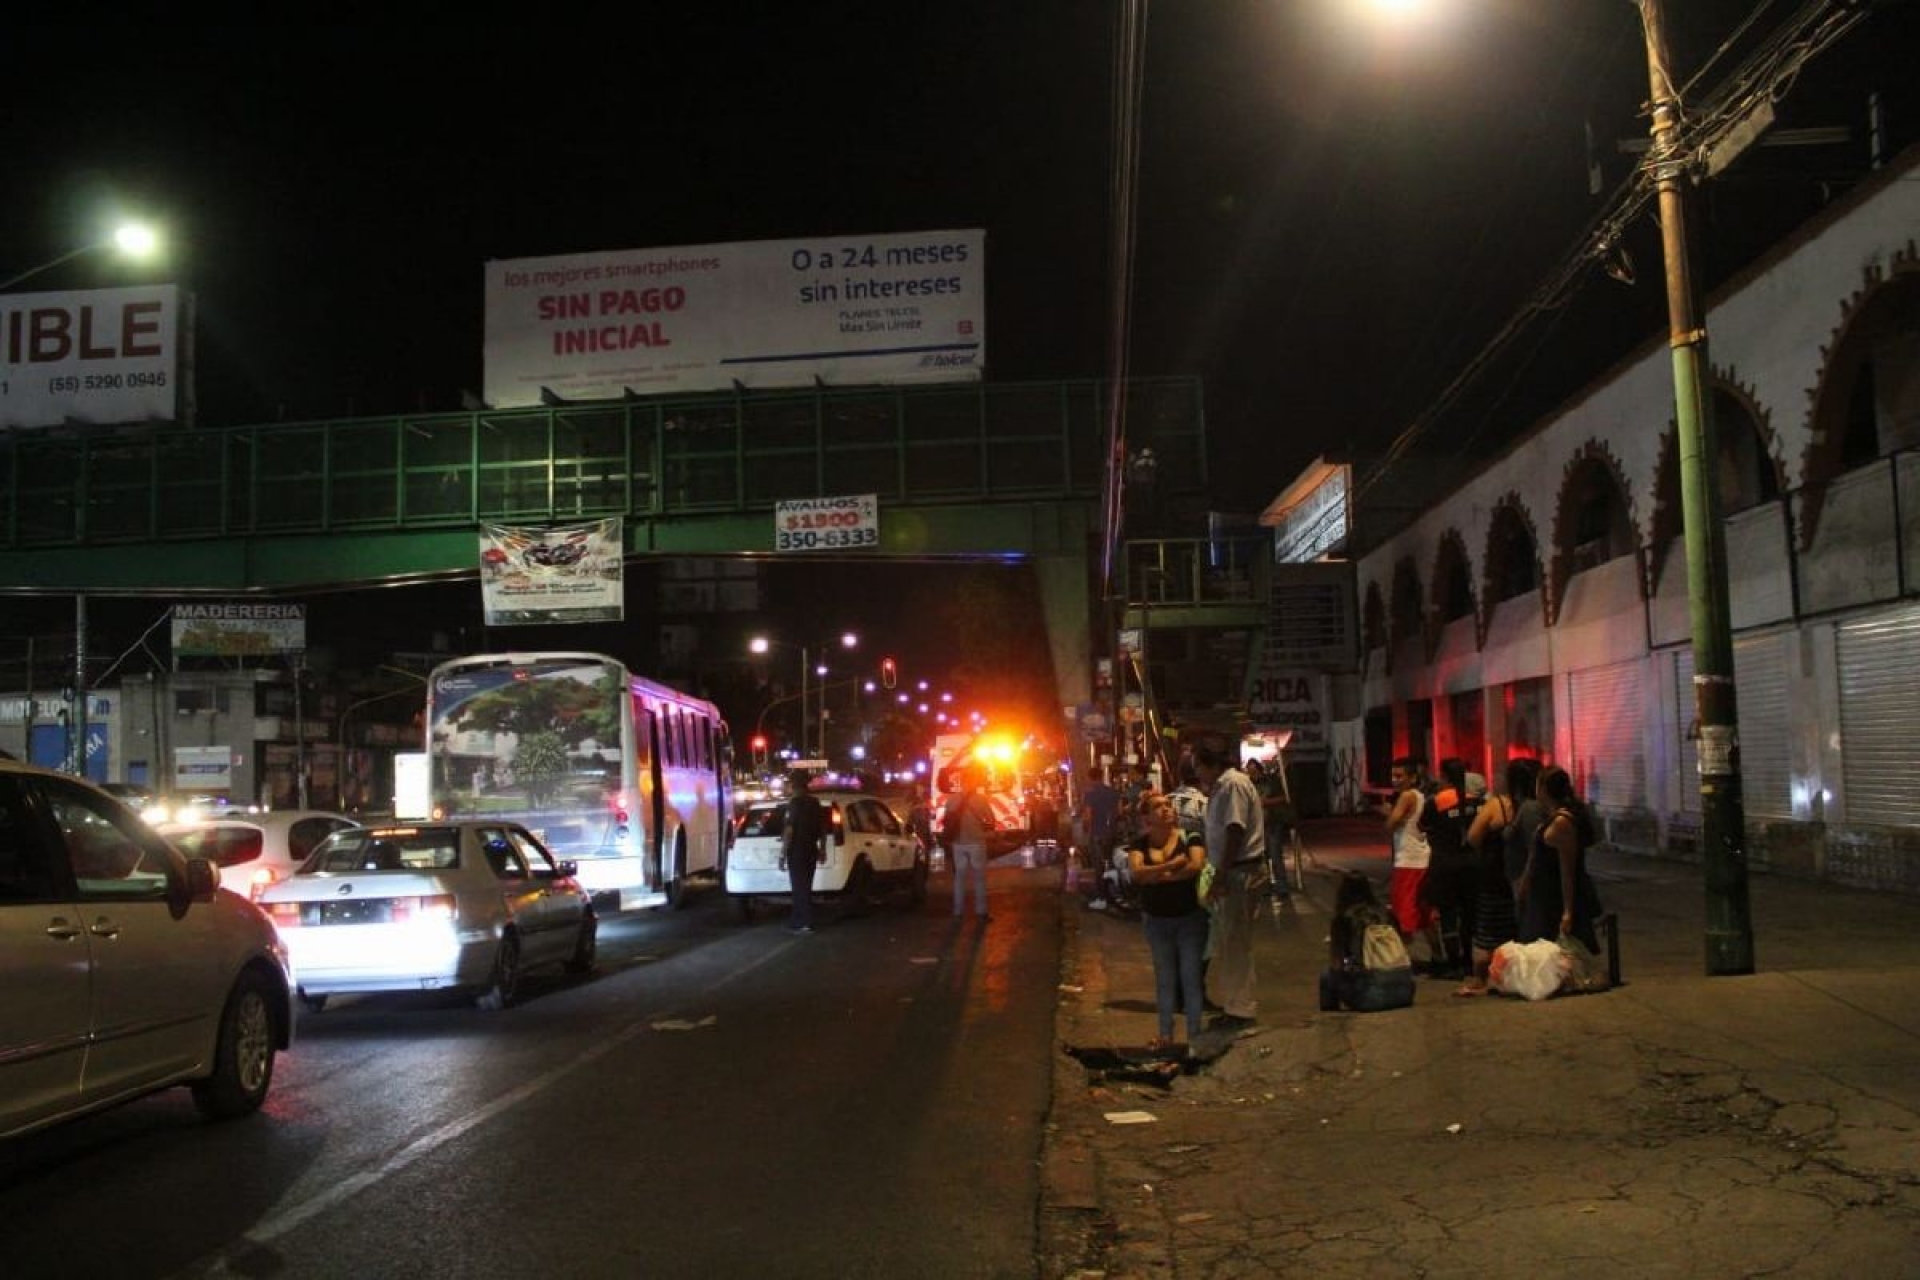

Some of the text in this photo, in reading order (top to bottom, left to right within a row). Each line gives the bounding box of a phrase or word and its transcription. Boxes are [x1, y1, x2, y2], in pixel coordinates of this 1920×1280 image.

[819, 252, 833, 269] a
[843, 245, 878, 268] 24
[886, 244, 967, 265] meses
[504, 256, 720, 287] los mejores smartphones
[537, 286, 685, 320] SIN PAGO
[801, 276, 960, 303] sin intereses
[0, 302, 162, 363] IBLE
[553, 323, 670, 355] INICIAL
[49, 376, 79, 394] (55)
[84, 374, 122, 389] 5290
[127, 371, 166, 388] 0946
[779, 528, 876, 550] 350-6333
[175, 603, 301, 619] MADERERIA
